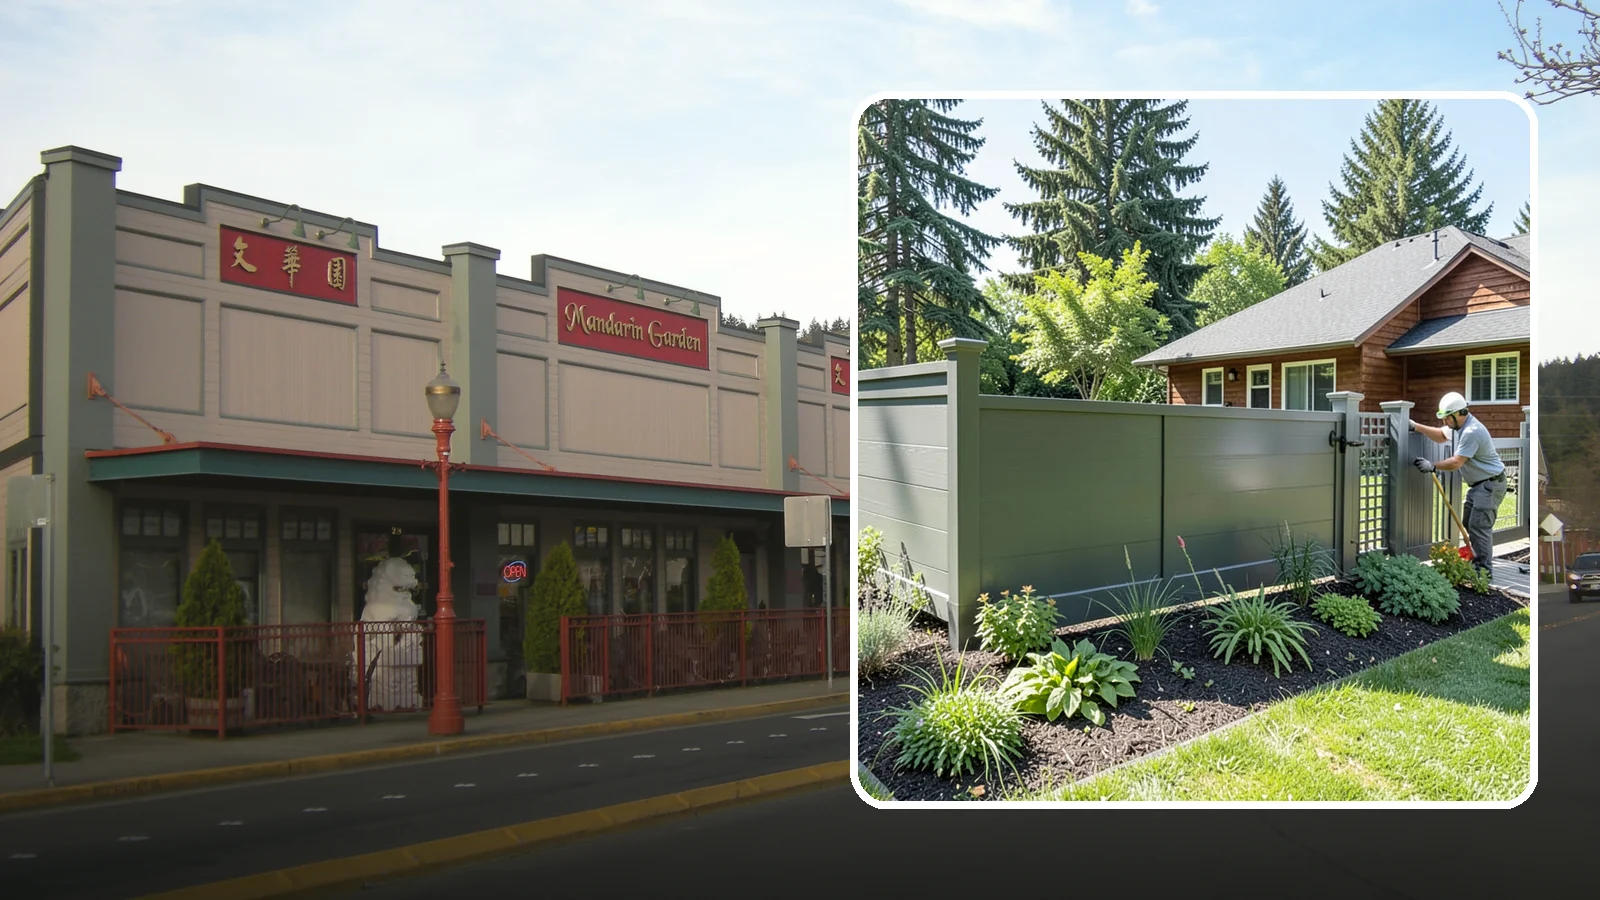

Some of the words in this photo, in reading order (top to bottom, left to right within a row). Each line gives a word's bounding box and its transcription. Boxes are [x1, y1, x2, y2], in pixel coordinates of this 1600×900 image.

[564, 302, 644, 341] Mandarin
[648, 320, 702, 352] Garden
[503, 565, 527, 578] OPEN
